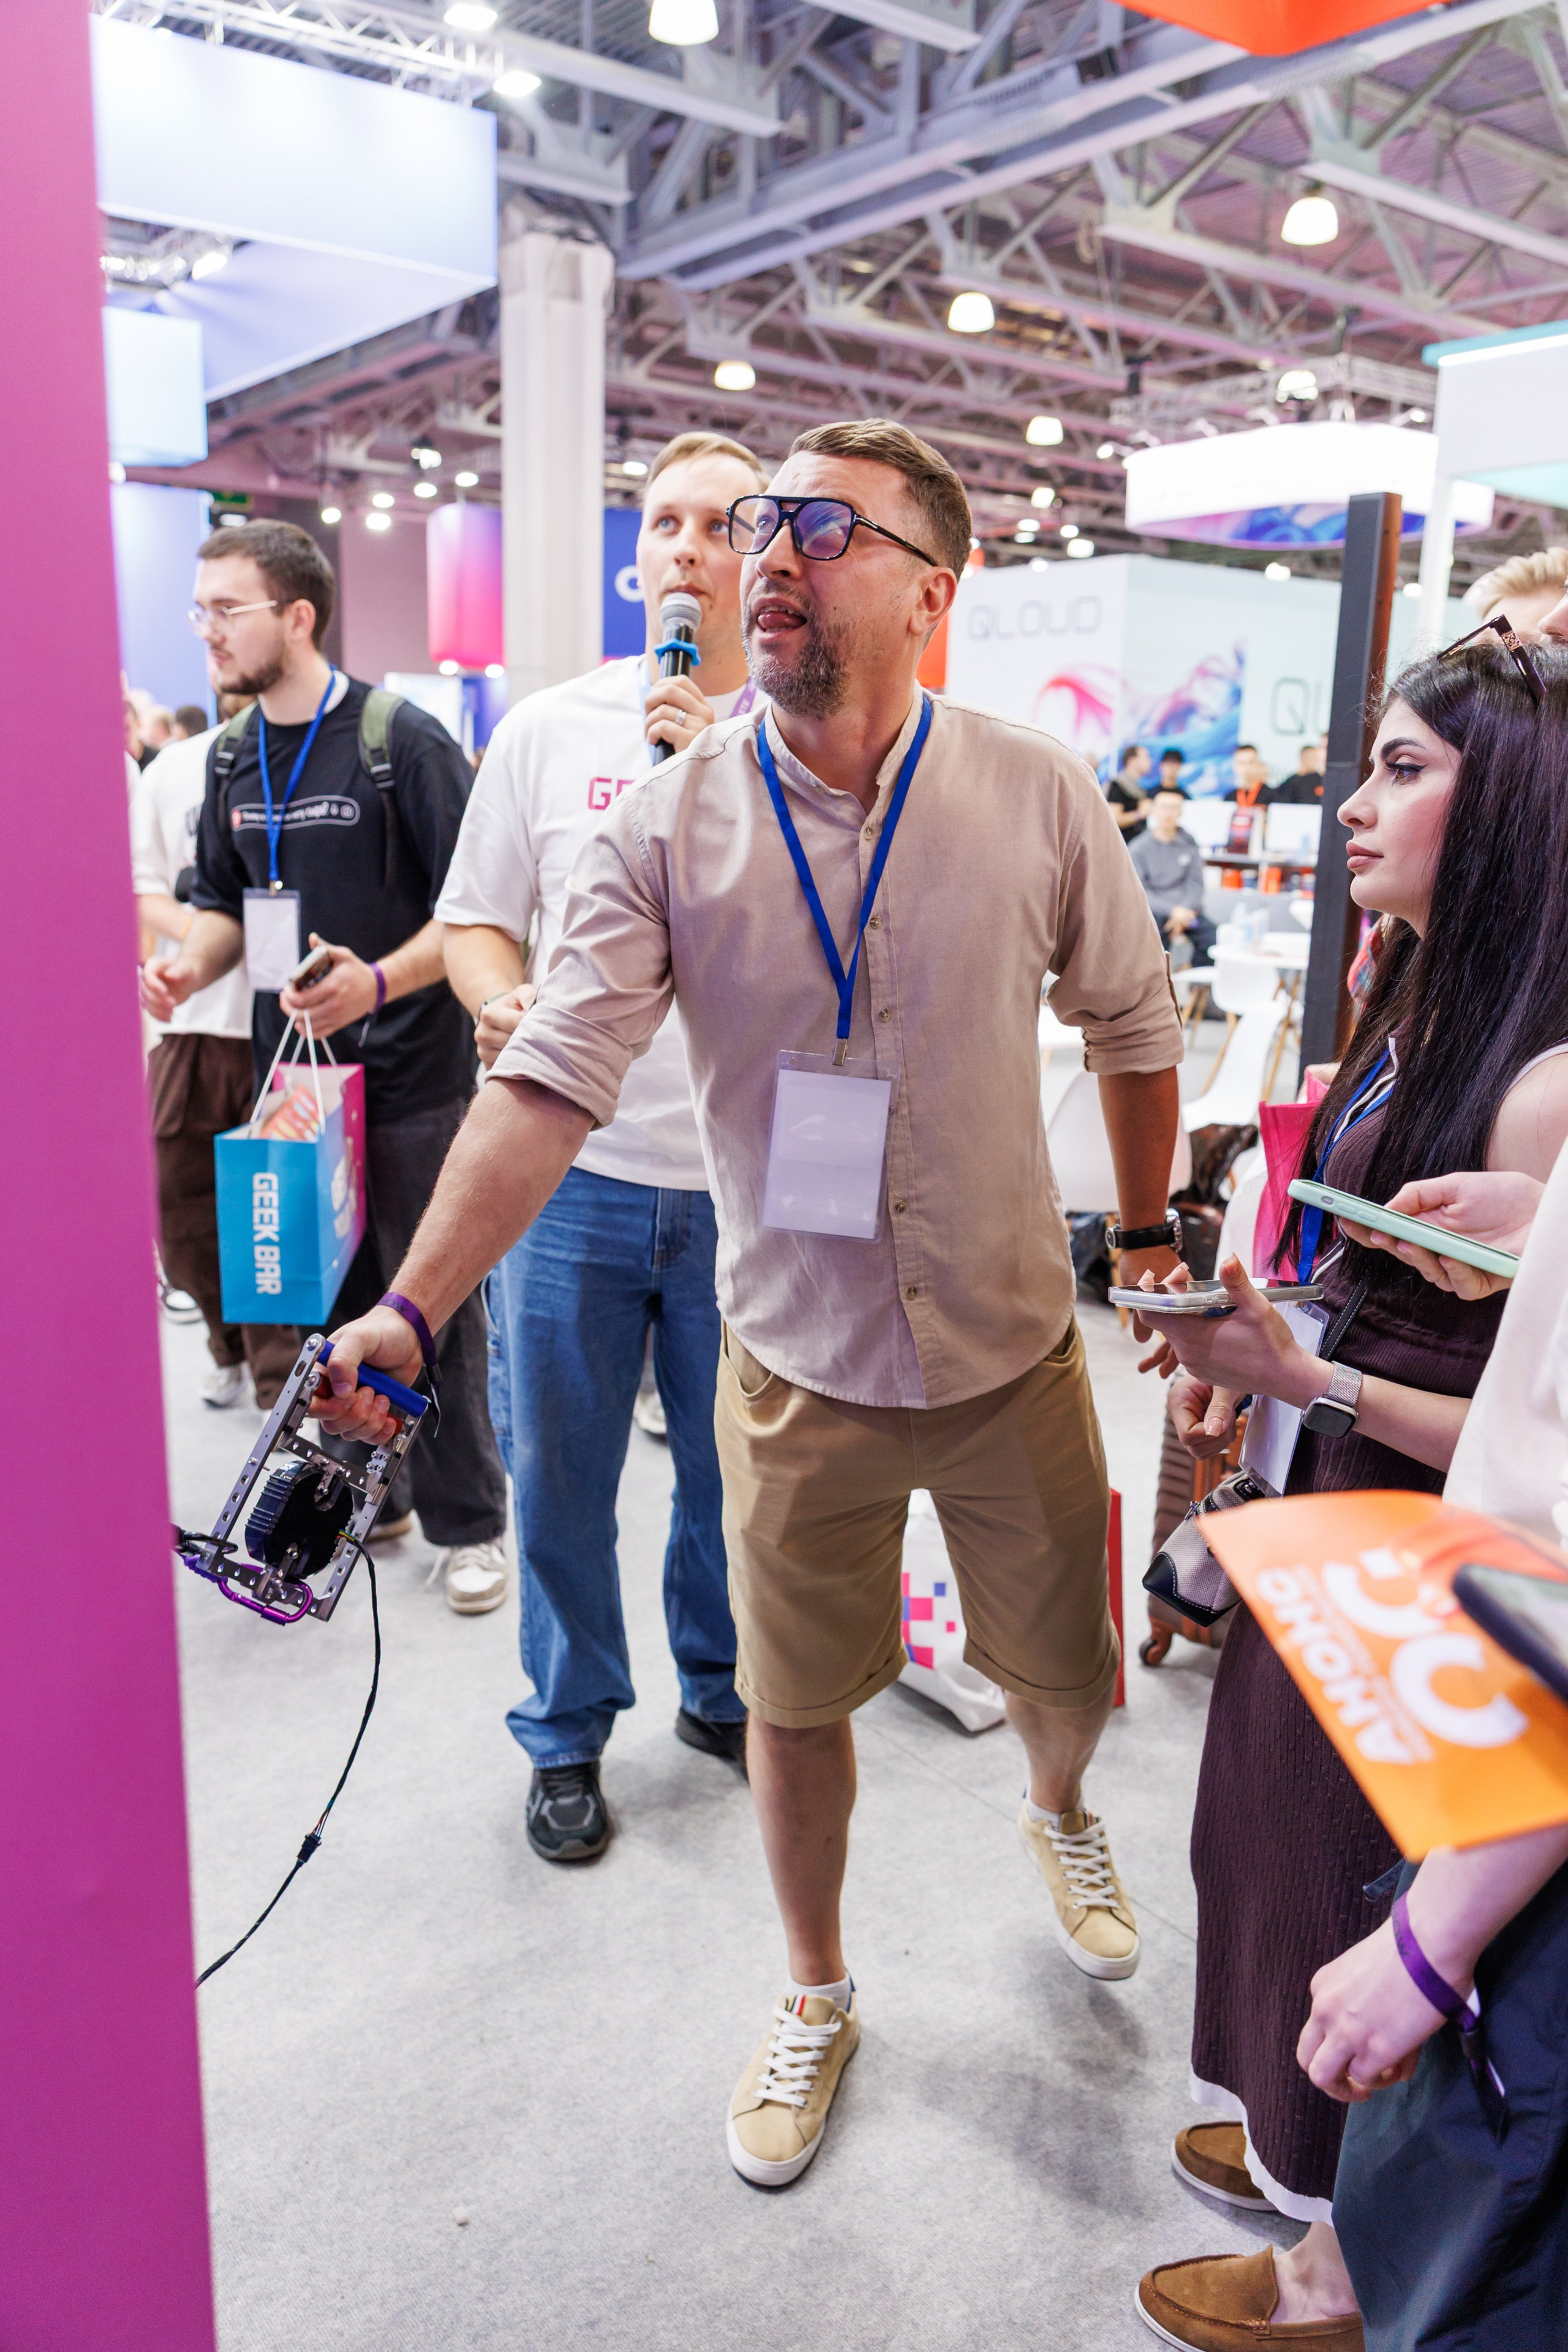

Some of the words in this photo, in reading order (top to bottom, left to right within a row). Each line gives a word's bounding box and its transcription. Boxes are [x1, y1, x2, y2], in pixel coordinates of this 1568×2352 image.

[970, 596, 1101, 641] QLOUD
[252, 1172, 280, 1243] GEEK
[254, 1245, 283, 1295] BAR
